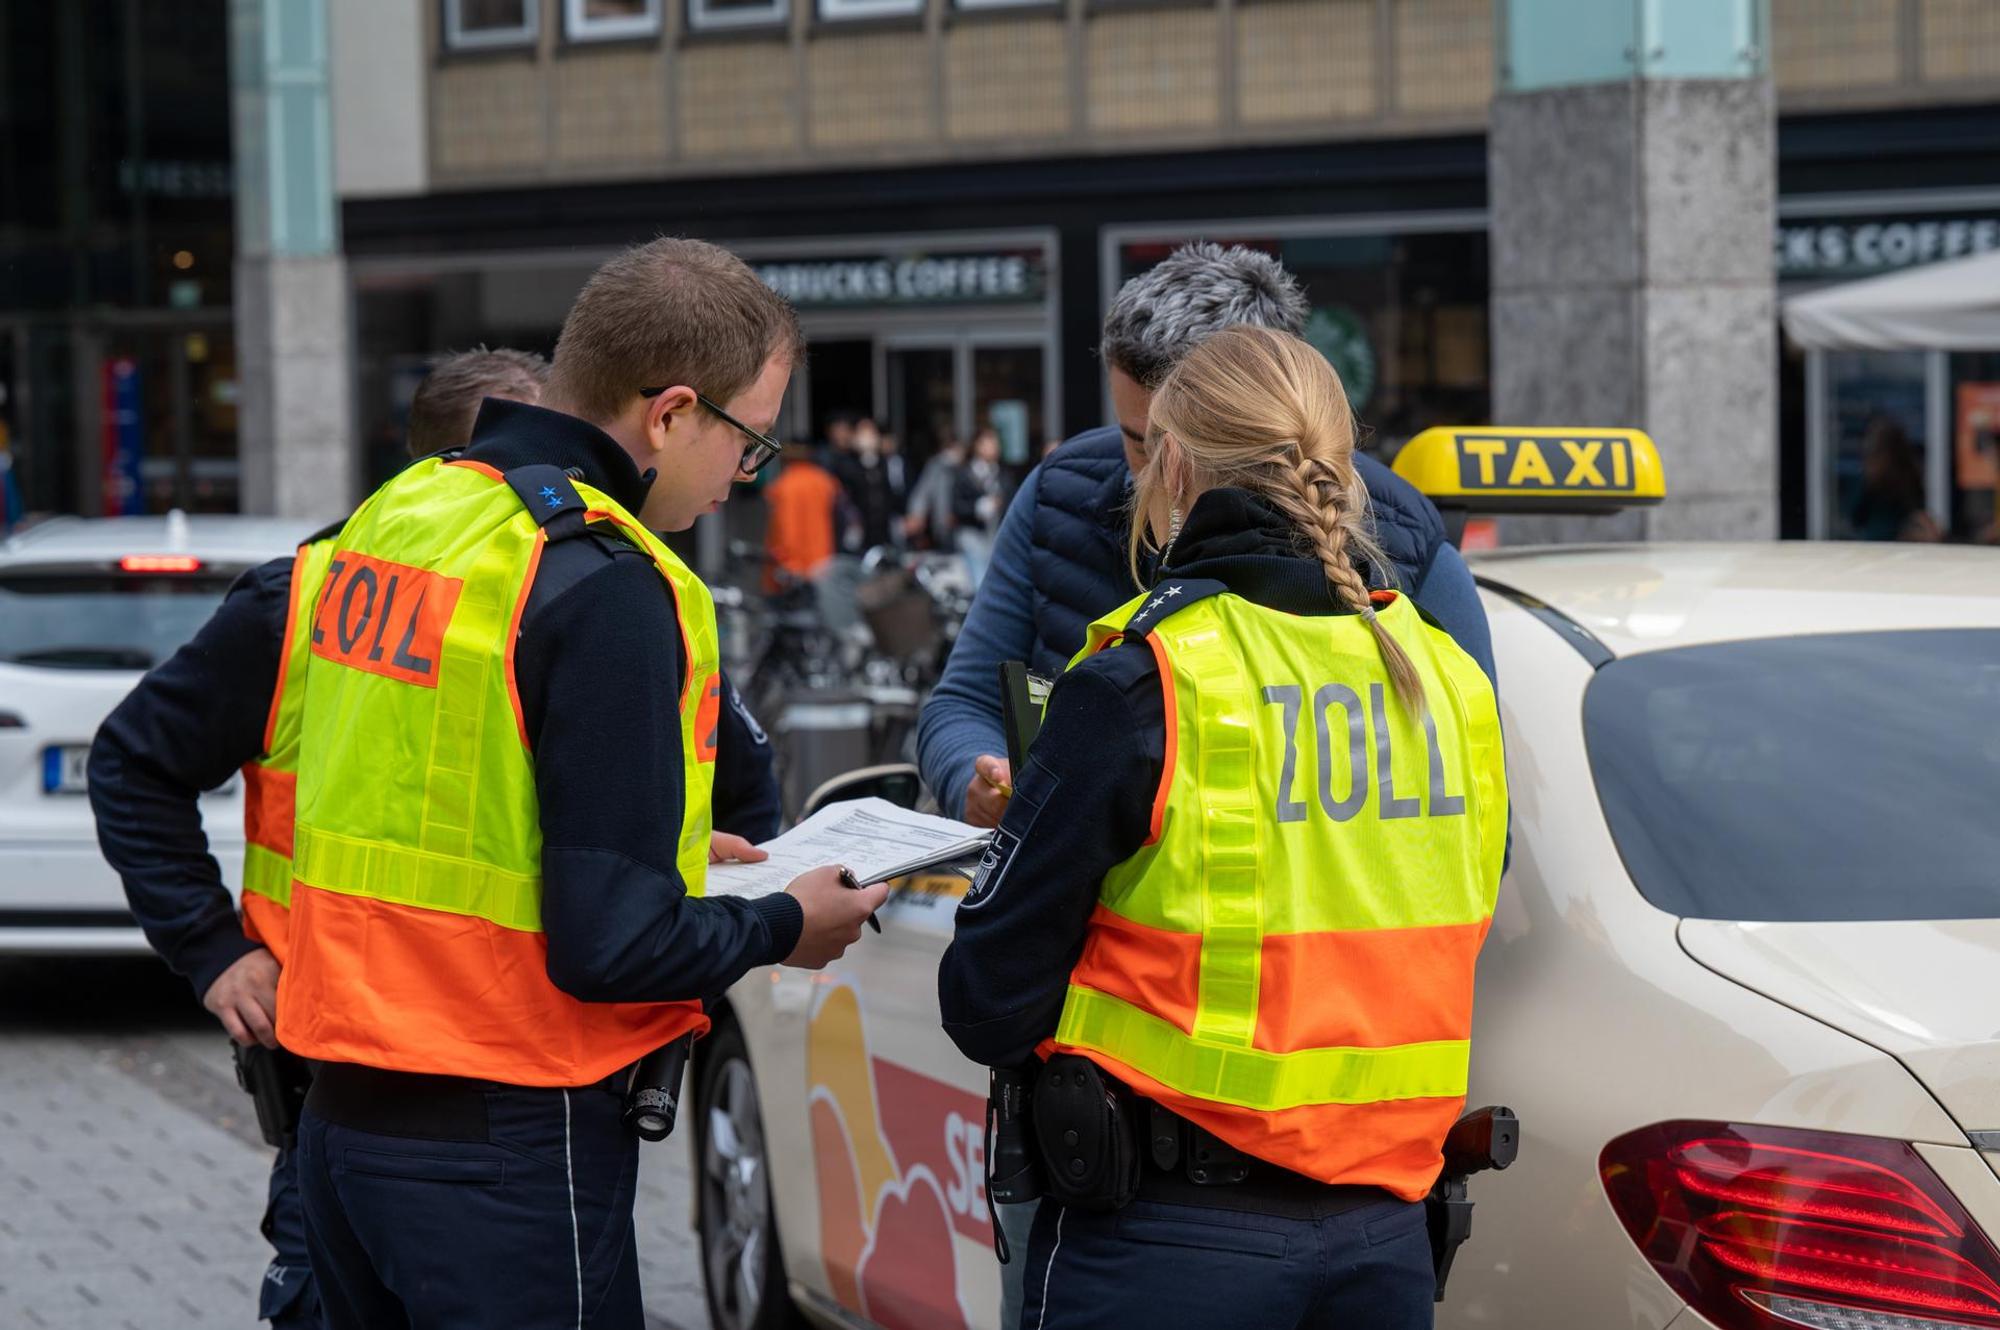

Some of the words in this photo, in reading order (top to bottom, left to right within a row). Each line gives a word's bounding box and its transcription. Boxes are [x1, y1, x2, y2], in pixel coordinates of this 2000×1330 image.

[896, 256, 1025, 298] COFFEE
[1463, 440, 1628, 486] TAXI
[313, 560, 432, 674] ZOLL
[1262, 683, 1466, 823] ZOLL
